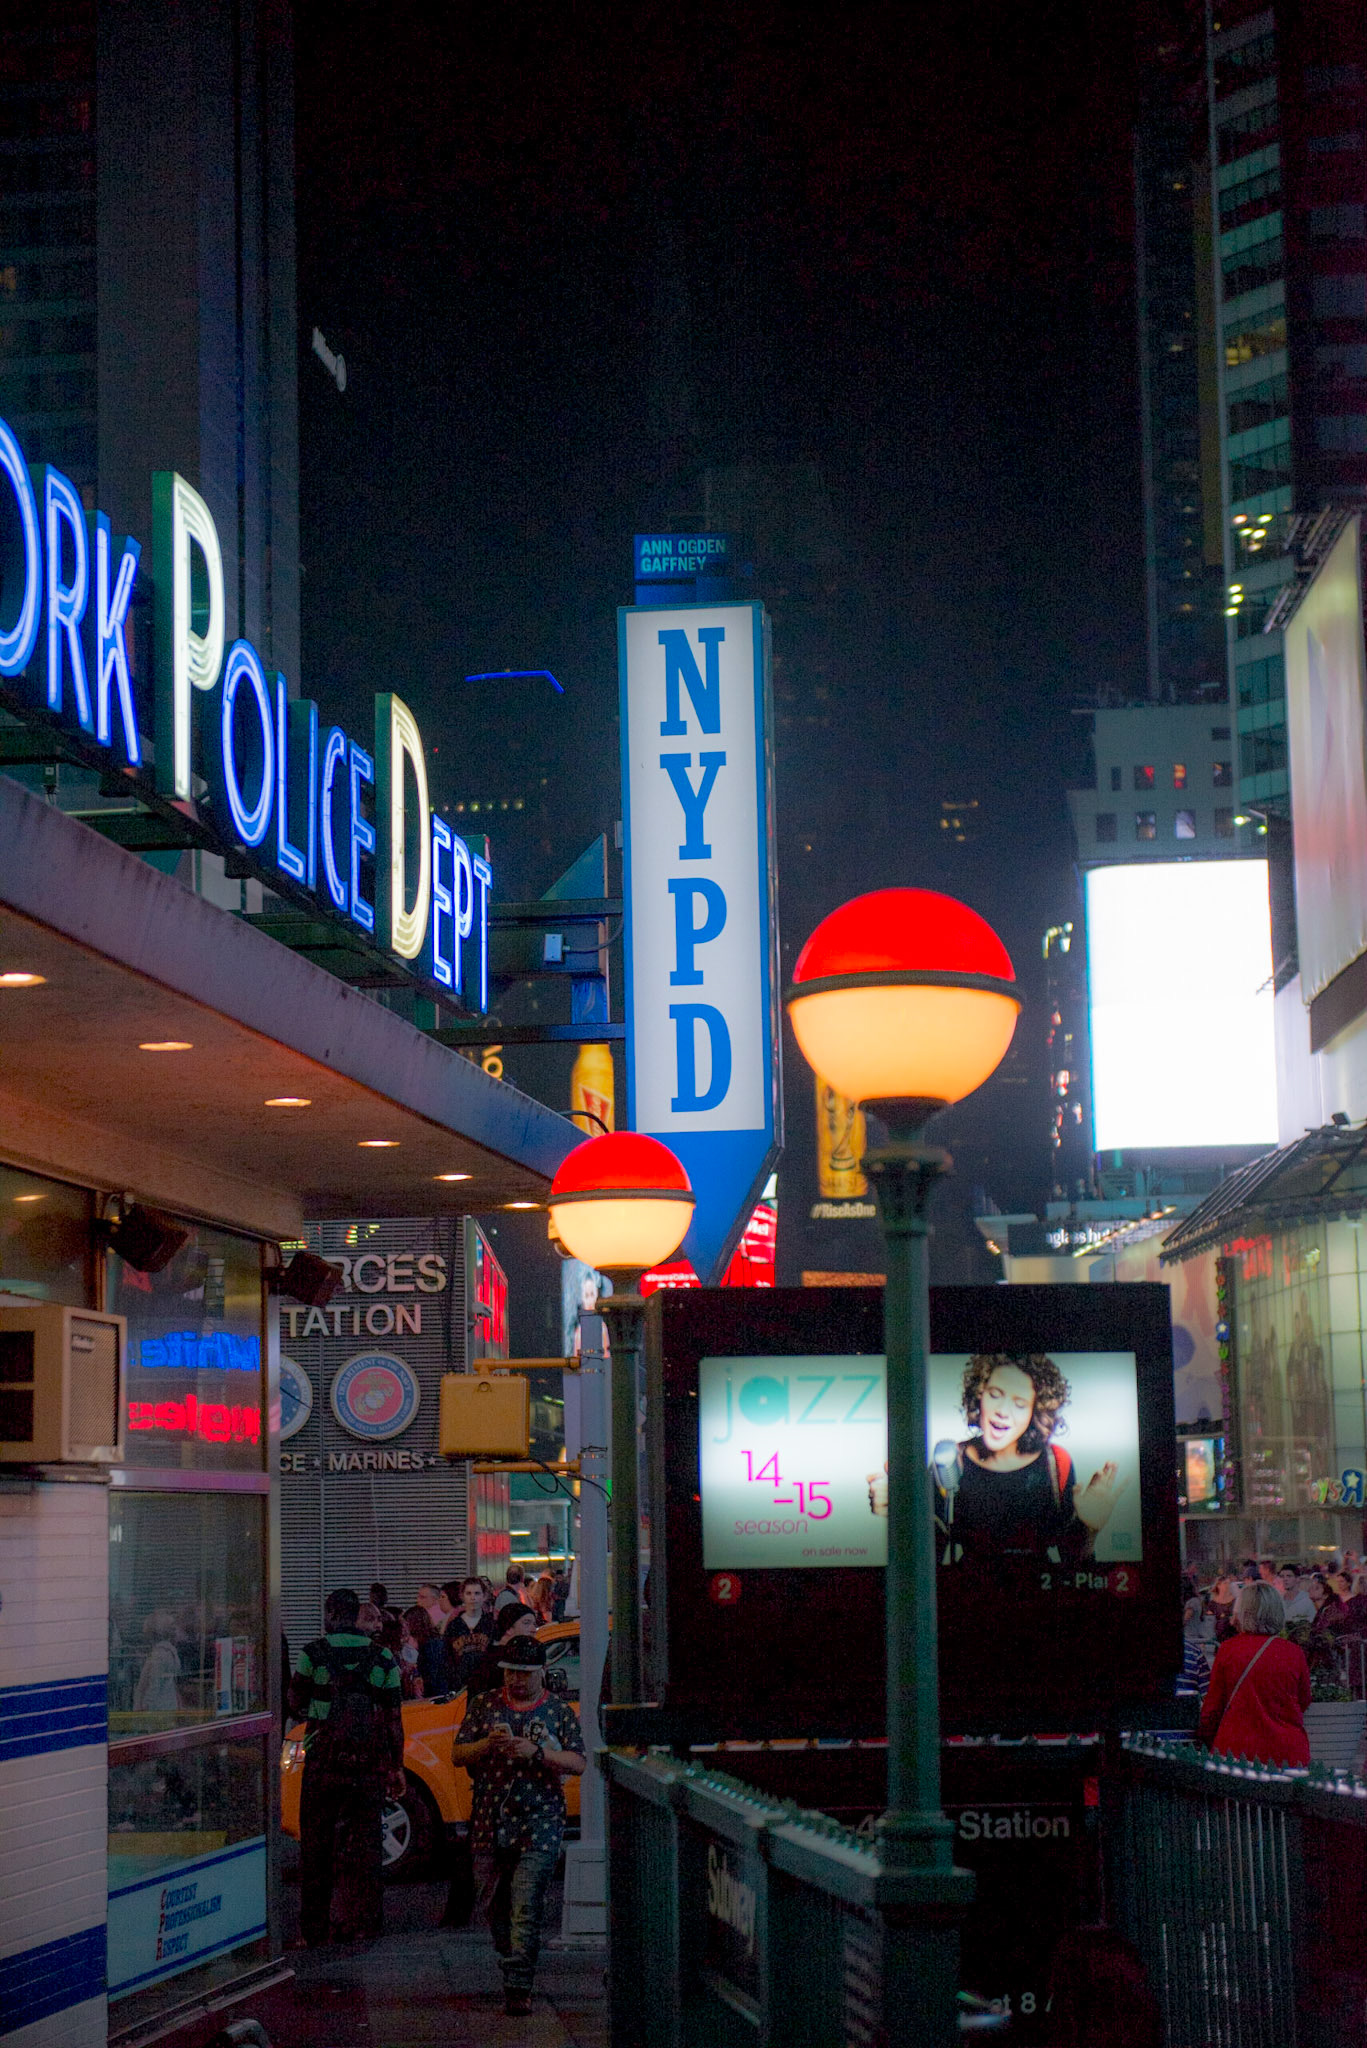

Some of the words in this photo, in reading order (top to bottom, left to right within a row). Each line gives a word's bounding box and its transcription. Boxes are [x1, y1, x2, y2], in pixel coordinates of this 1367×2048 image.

[640, 540, 673, 556] ANN
[677, 538, 726, 555] OGDEN
[640, 556, 707, 572] GAFFNEY
[172, 471, 376, 933] POLICE
[391, 692, 493, 1015] DEPT
[657, 625, 732, 1114] NYPD
[283, 1254, 447, 1293] RCES
[713, 1366, 884, 1444] jazz
[328, 1452, 425, 1472] MARINES
[740, 1450, 784, 1488] 14
[733, 1518, 809, 1536] season
[802, 1548, 817, 1556] on
[819, 1546, 841, 1556] sale
[844, 1547, 868, 1555] now
[718, 1578, 732, 1600] 2
[1040, 1573, 1052, 1591] 2
[1115, 1571, 1130, 1592] 2
[958, 1810, 1072, 1840] Station
[1020, 1992, 1037, 2014] 8
